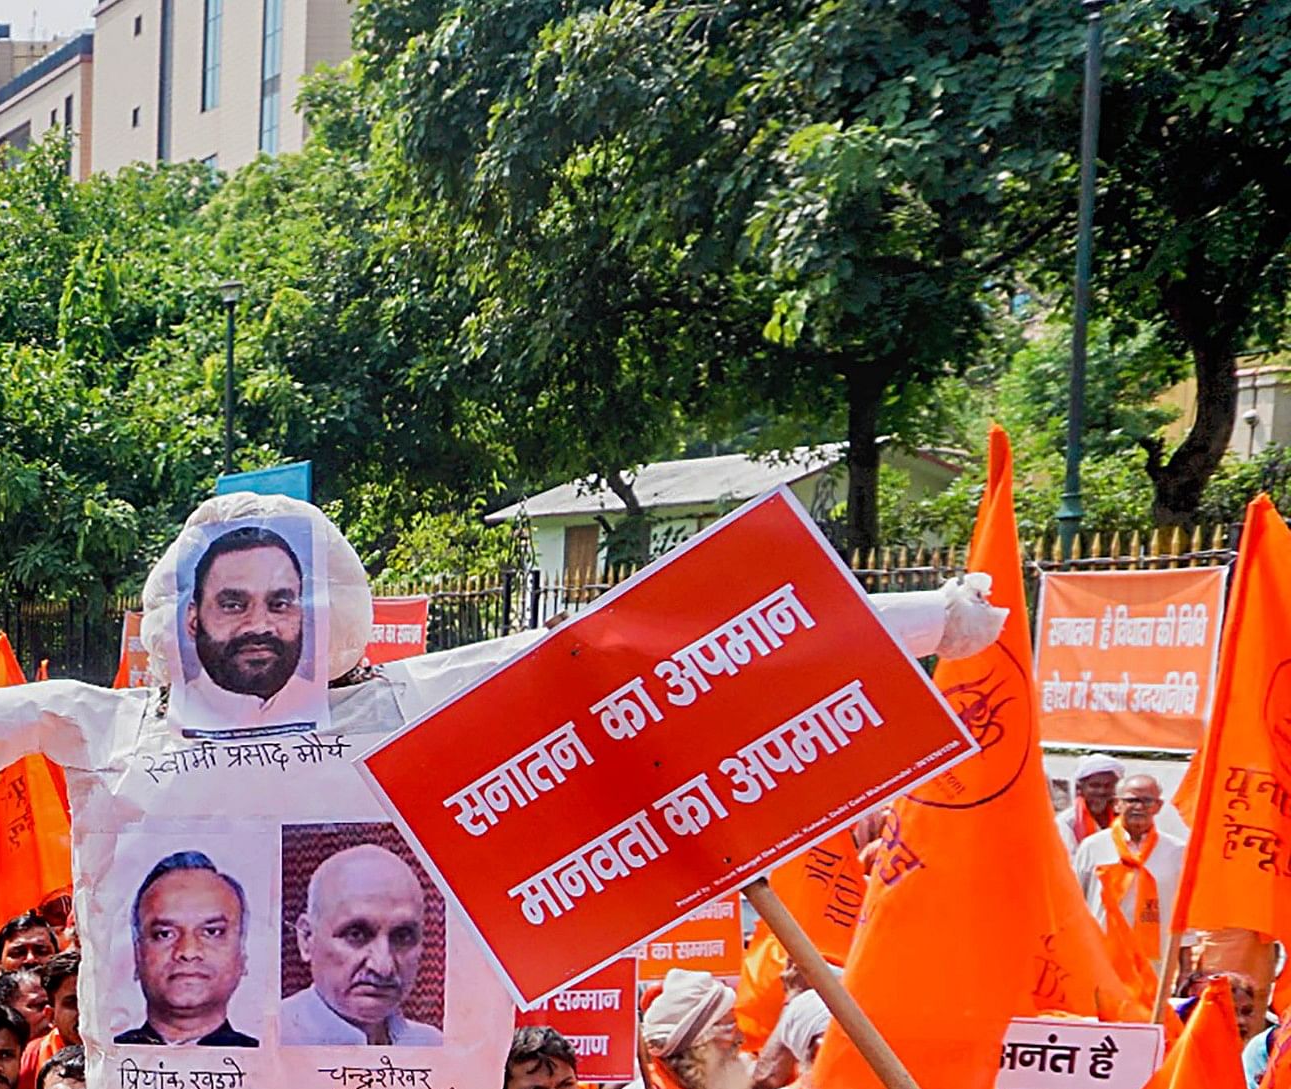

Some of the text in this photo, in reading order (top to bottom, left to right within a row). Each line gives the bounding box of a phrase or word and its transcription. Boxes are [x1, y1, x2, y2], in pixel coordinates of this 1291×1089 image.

[443, 582, 816, 837] सनातन का अपमान
[508, 679, 884, 927] मानवता का अपमान
[651, 943, 674, 960] का
[553, 989, 623, 1012] सम्मान
[1089, 1035, 1119, 1080] है
